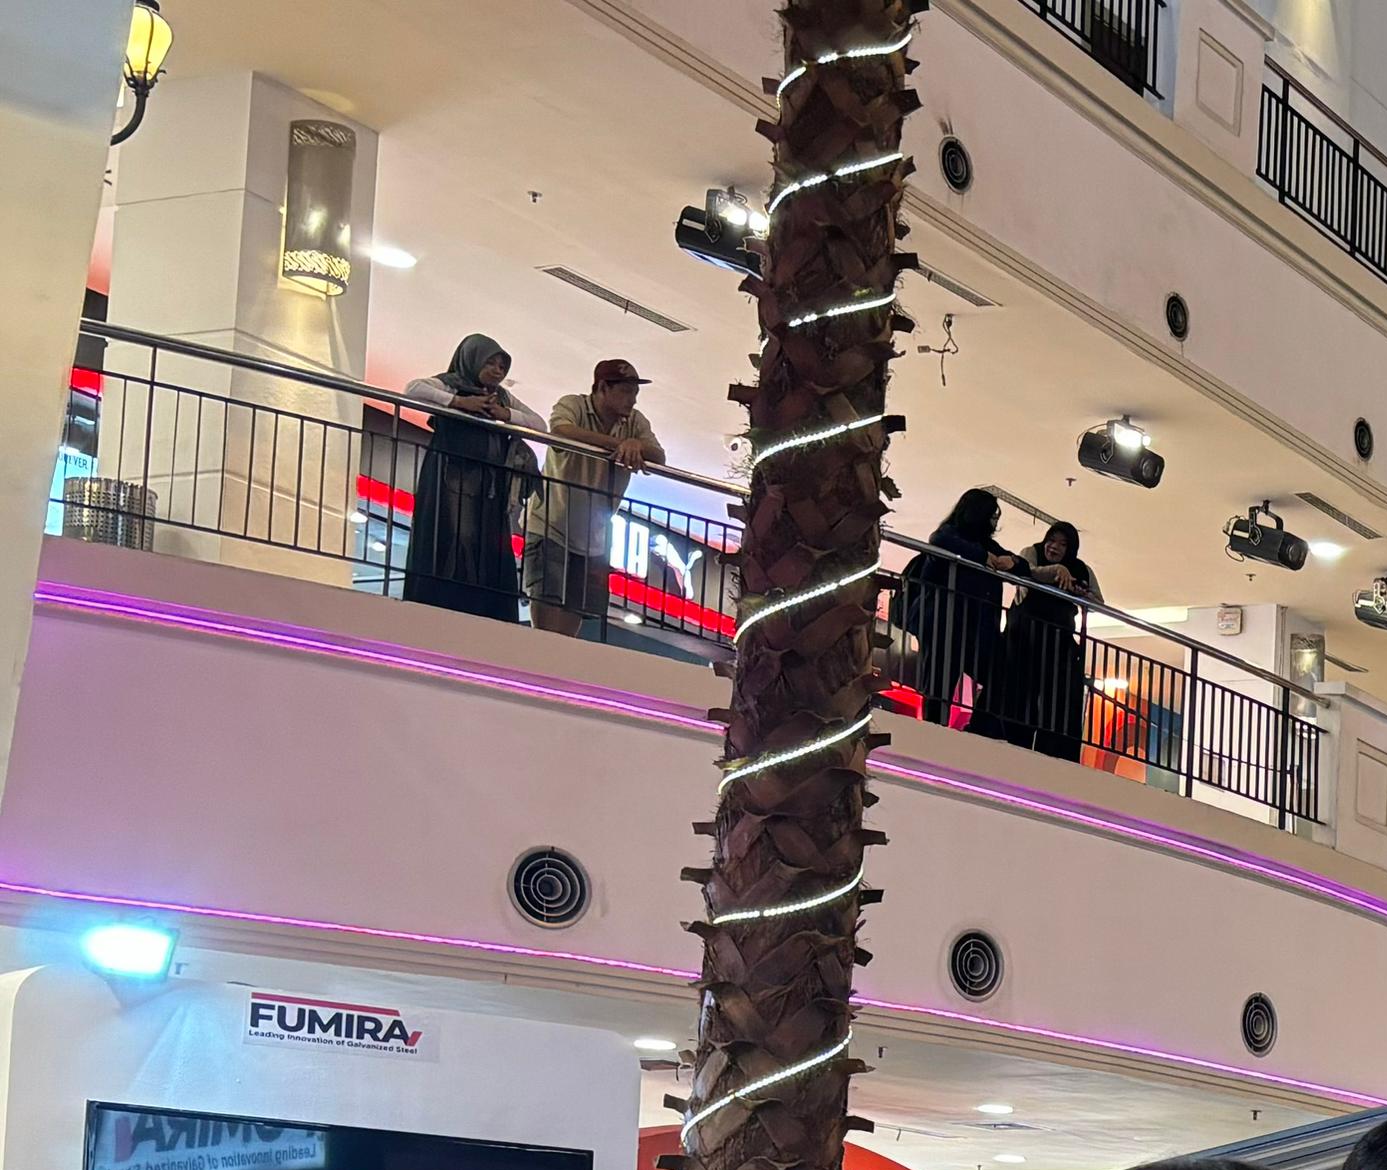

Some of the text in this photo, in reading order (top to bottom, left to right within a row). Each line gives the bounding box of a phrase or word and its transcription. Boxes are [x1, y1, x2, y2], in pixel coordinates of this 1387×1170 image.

[250, 1002, 410, 1046] FUMIRA
[249, 1030, 285, 1041] Leading
[288, 1034, 334, 1046] Innovation
[347, 1041, 394, 1053] Galvanized
[396, 1046, 418, 1055] Steel
